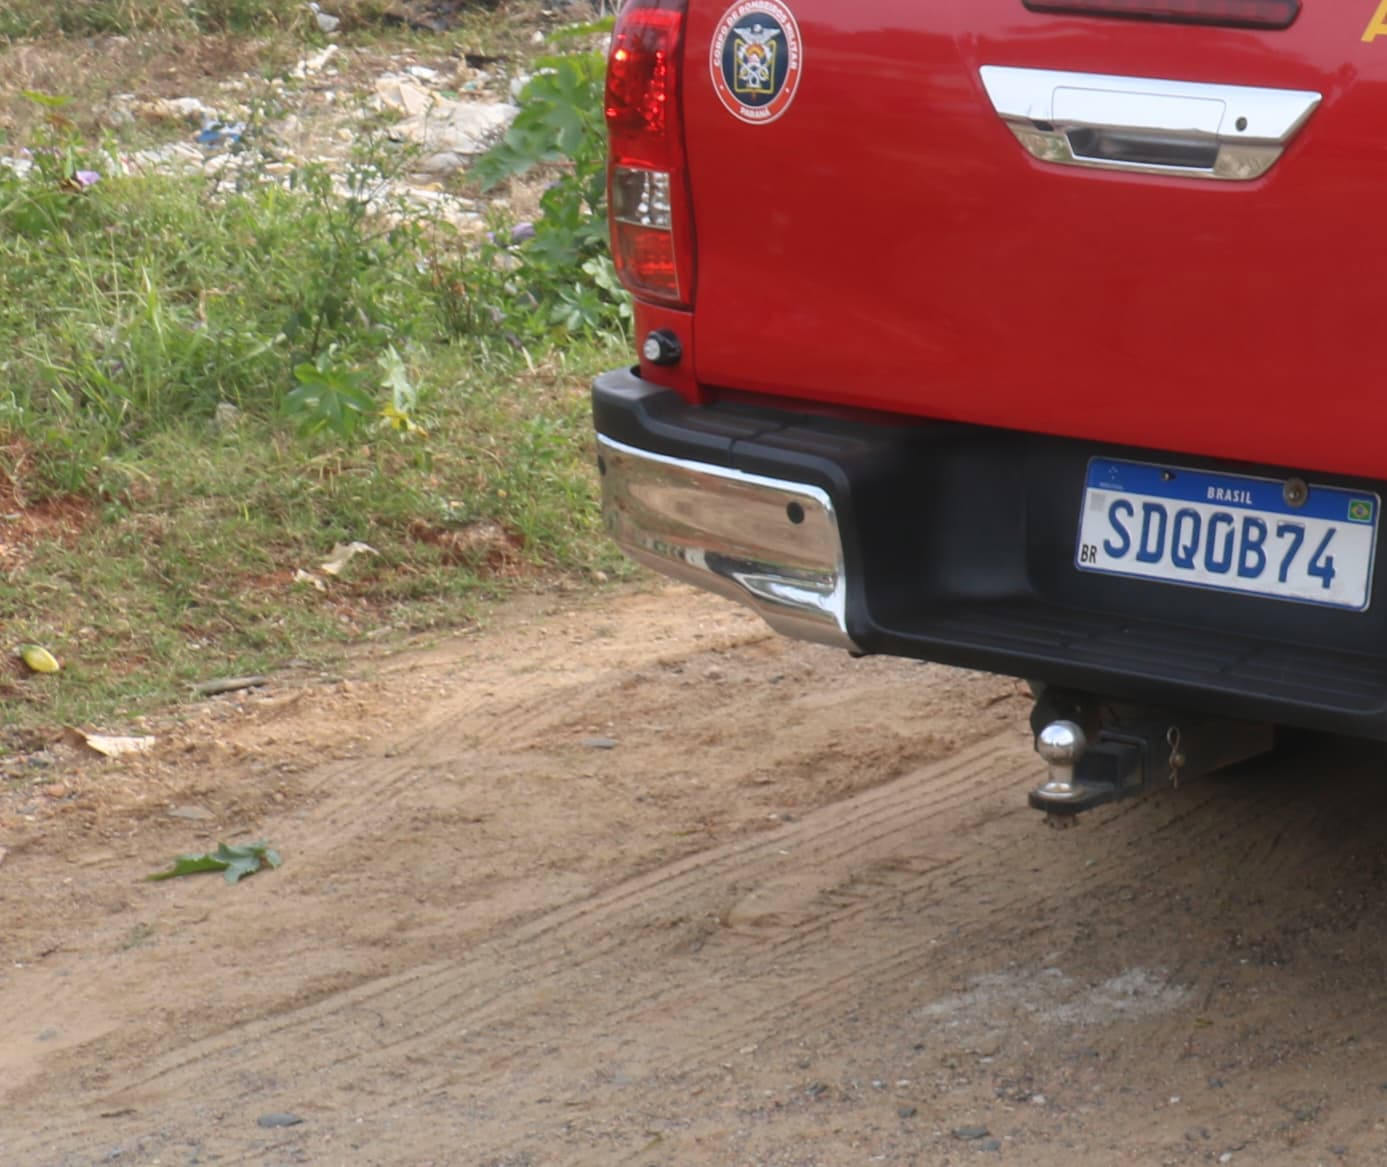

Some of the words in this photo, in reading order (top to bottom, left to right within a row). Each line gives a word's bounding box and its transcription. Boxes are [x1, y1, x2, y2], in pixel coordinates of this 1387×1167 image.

[1206, 485, 1253, 505] BRASIL
[1080, 544, 1097, 564] BR
[1102, 498, 1337, 590] SDQ0B74
